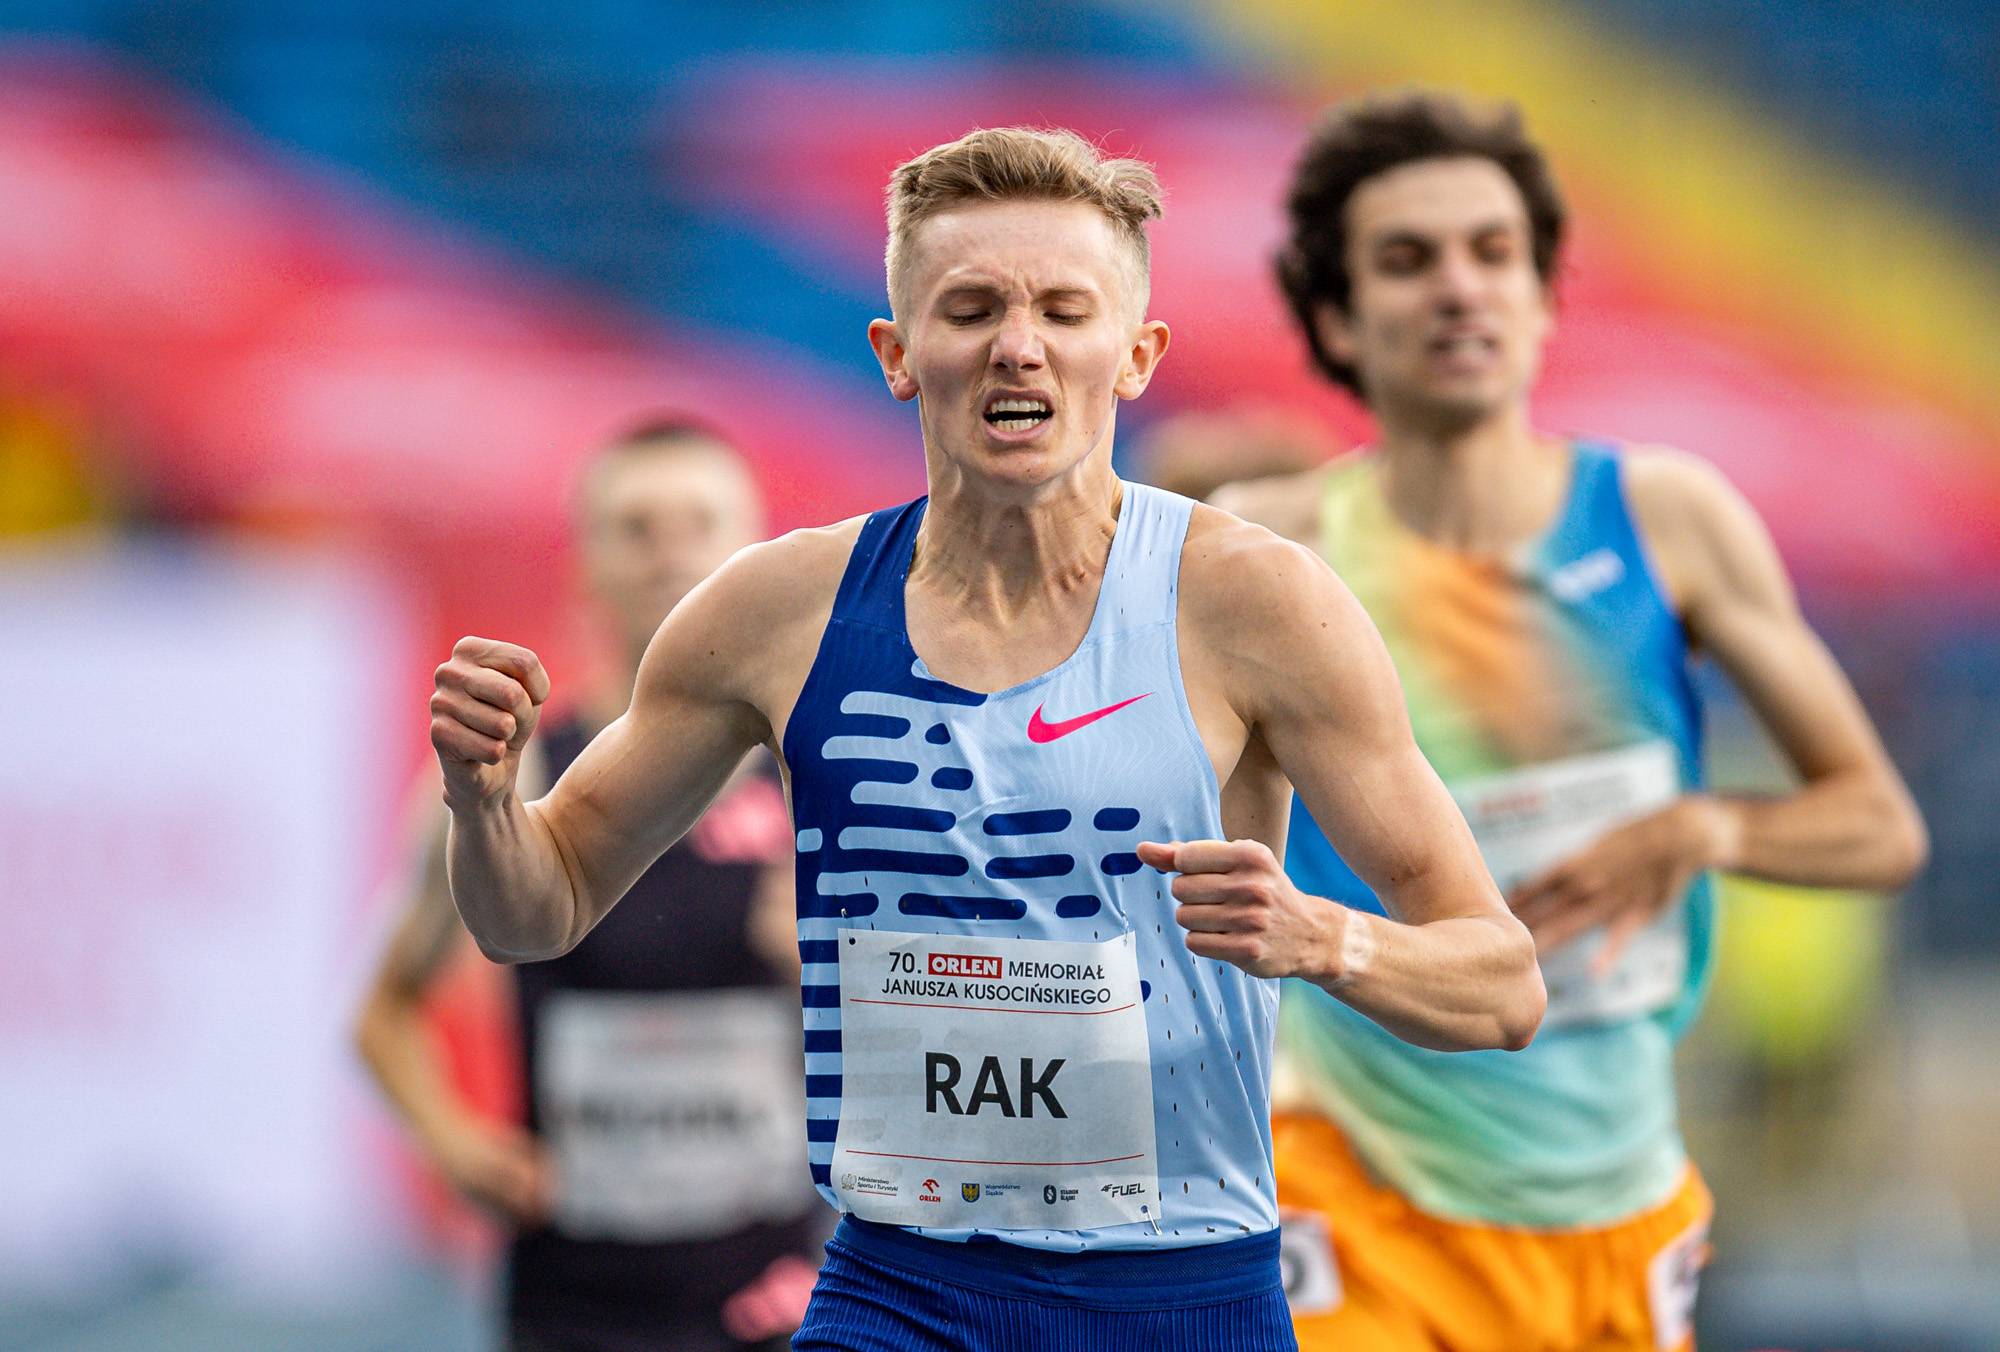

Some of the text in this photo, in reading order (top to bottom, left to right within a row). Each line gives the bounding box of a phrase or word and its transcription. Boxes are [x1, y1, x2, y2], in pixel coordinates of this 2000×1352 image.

[888, 951, 1105, 980] 70. ORLEN MEMORIAŁ
[882, 978, 1111, 1005] JANUSZA KUSOCIŃSKIEGO
[925, 1052, 1069, 1119] RAK
[1112, 1183, 1146, 1198] FUEL
